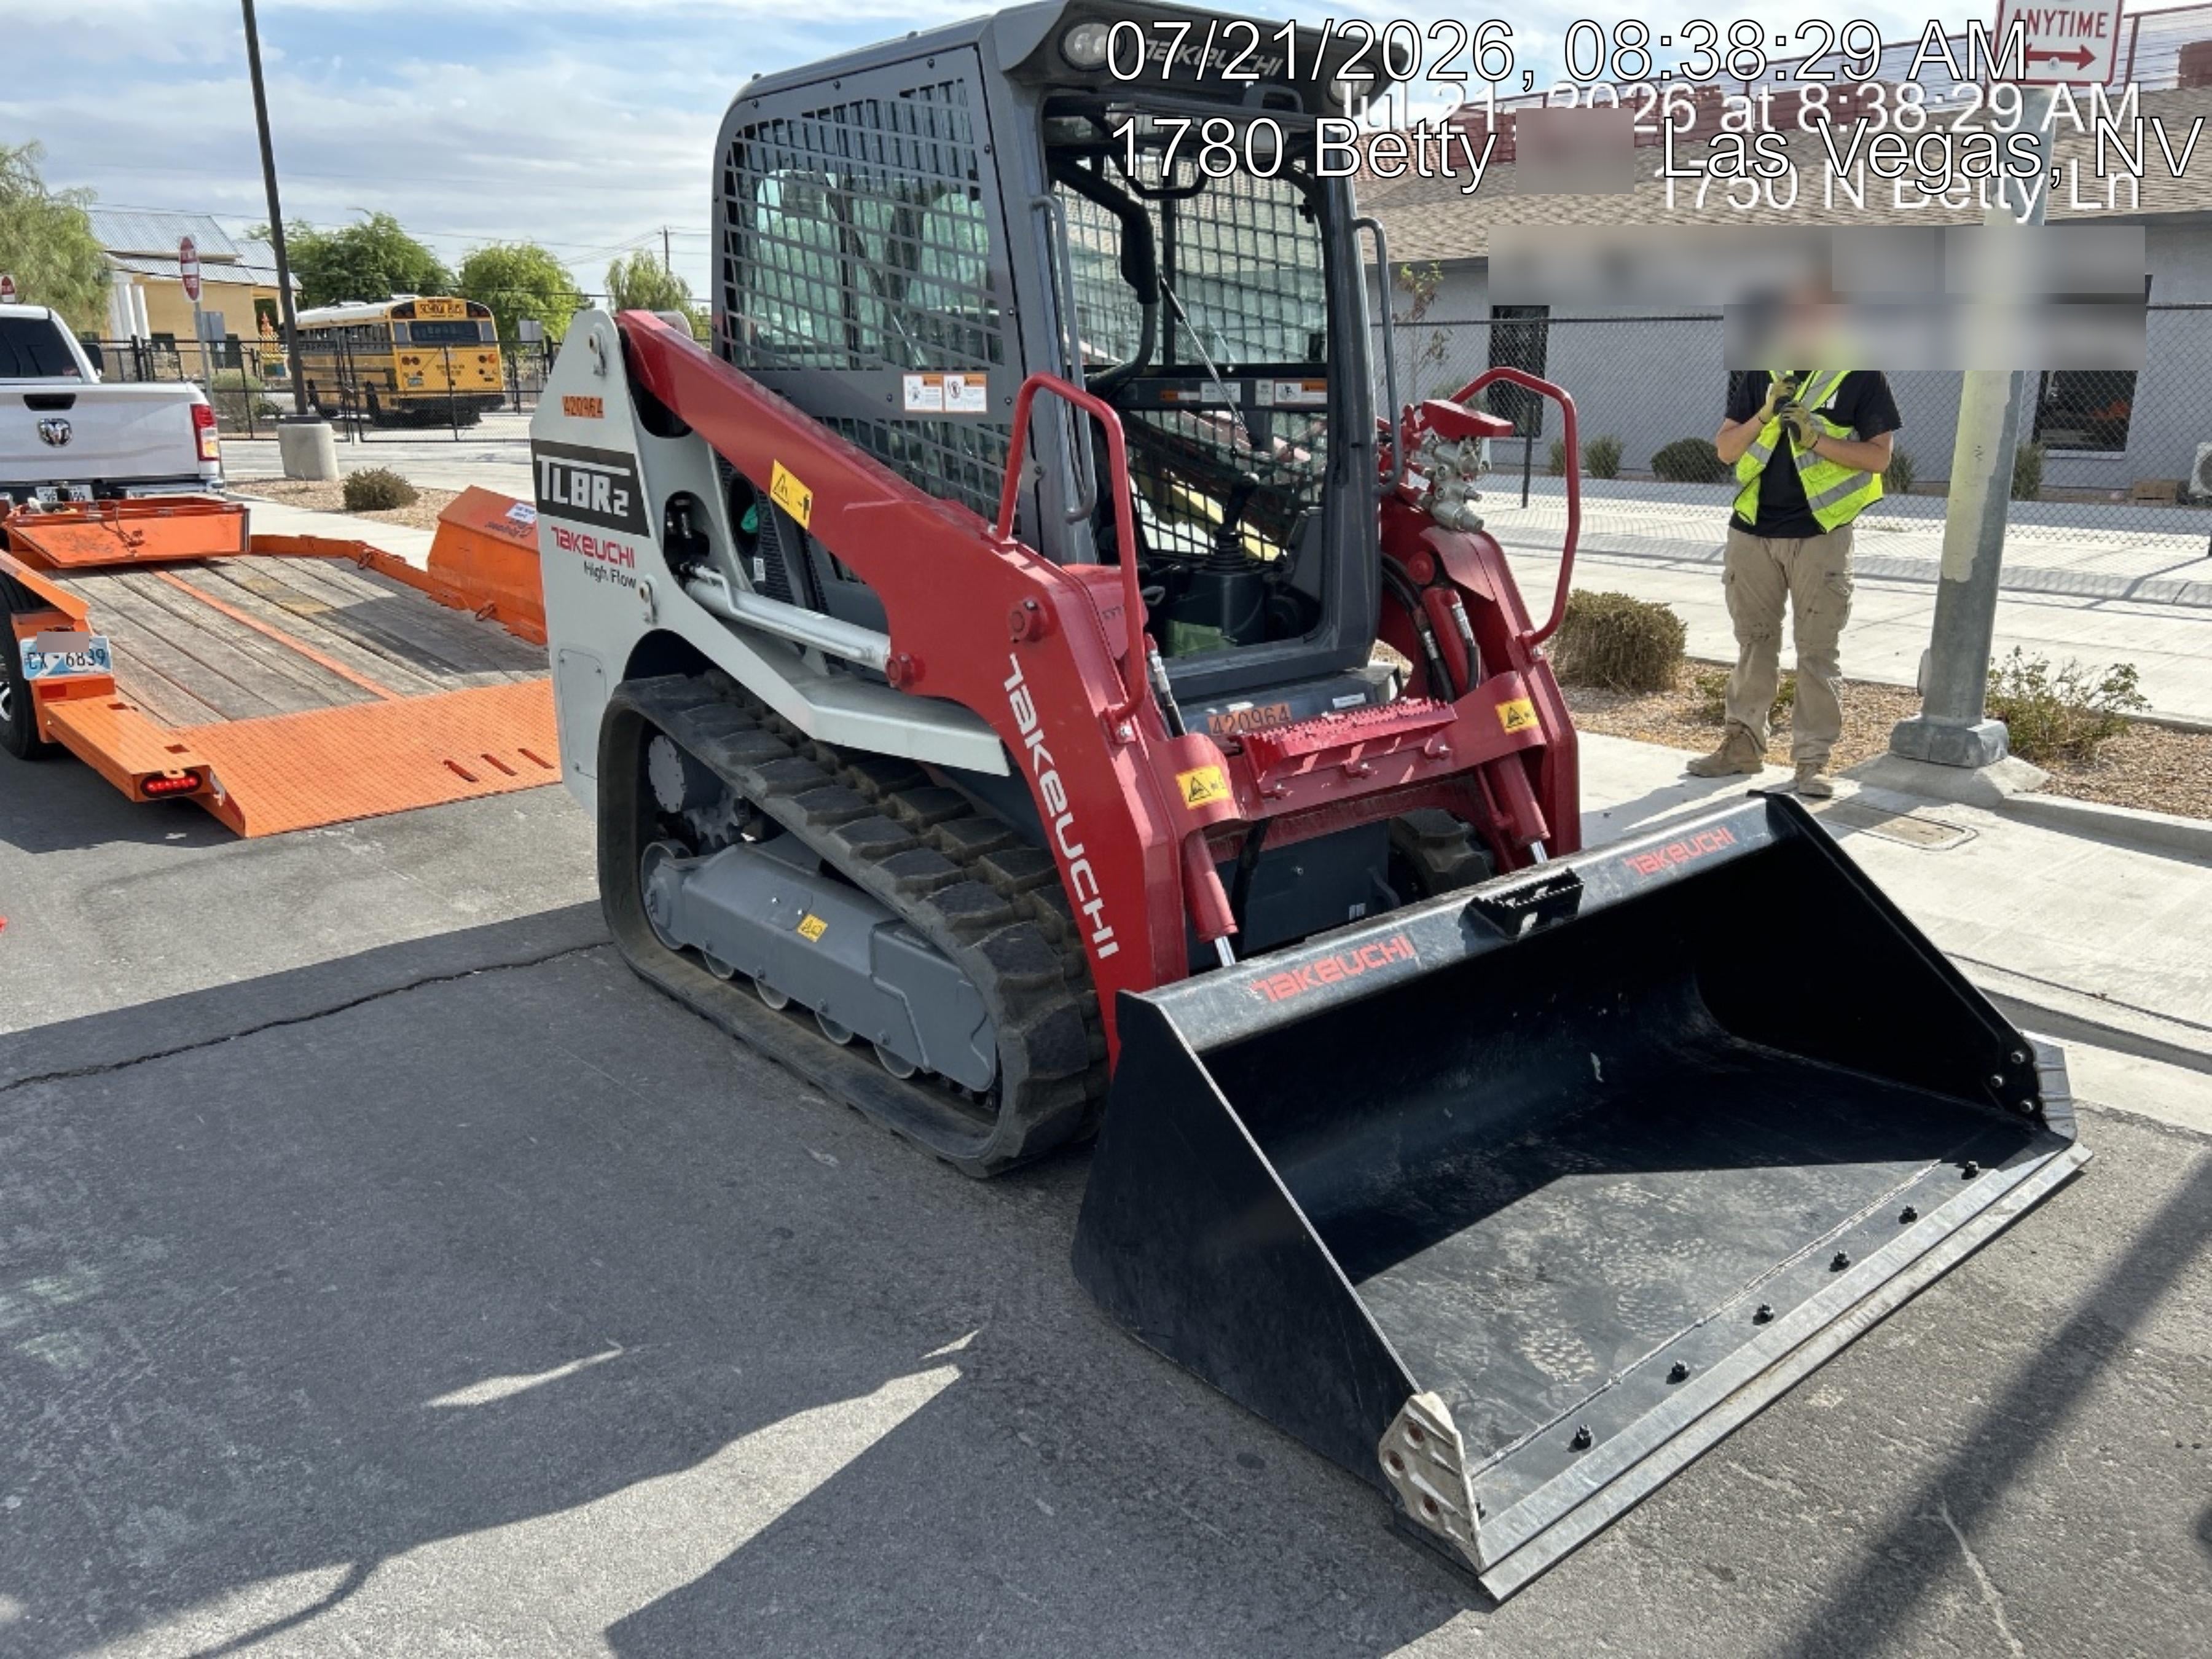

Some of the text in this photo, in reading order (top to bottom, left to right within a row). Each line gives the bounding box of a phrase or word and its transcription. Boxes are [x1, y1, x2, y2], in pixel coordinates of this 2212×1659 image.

[2012, 9, 2109, 38] ANYTIME
[551, 527, 635, 569] TAKEUCHI
[584, 560, 637, 589] High Flow
[1210, 706, 1290, 735] 420964
[1002, 653, 1120, 959] TAKEUCHI
[1625, 826, 1736, 875] TAKEUCHI
[1250, 935, 1416, 1002] TAKEUCHI
